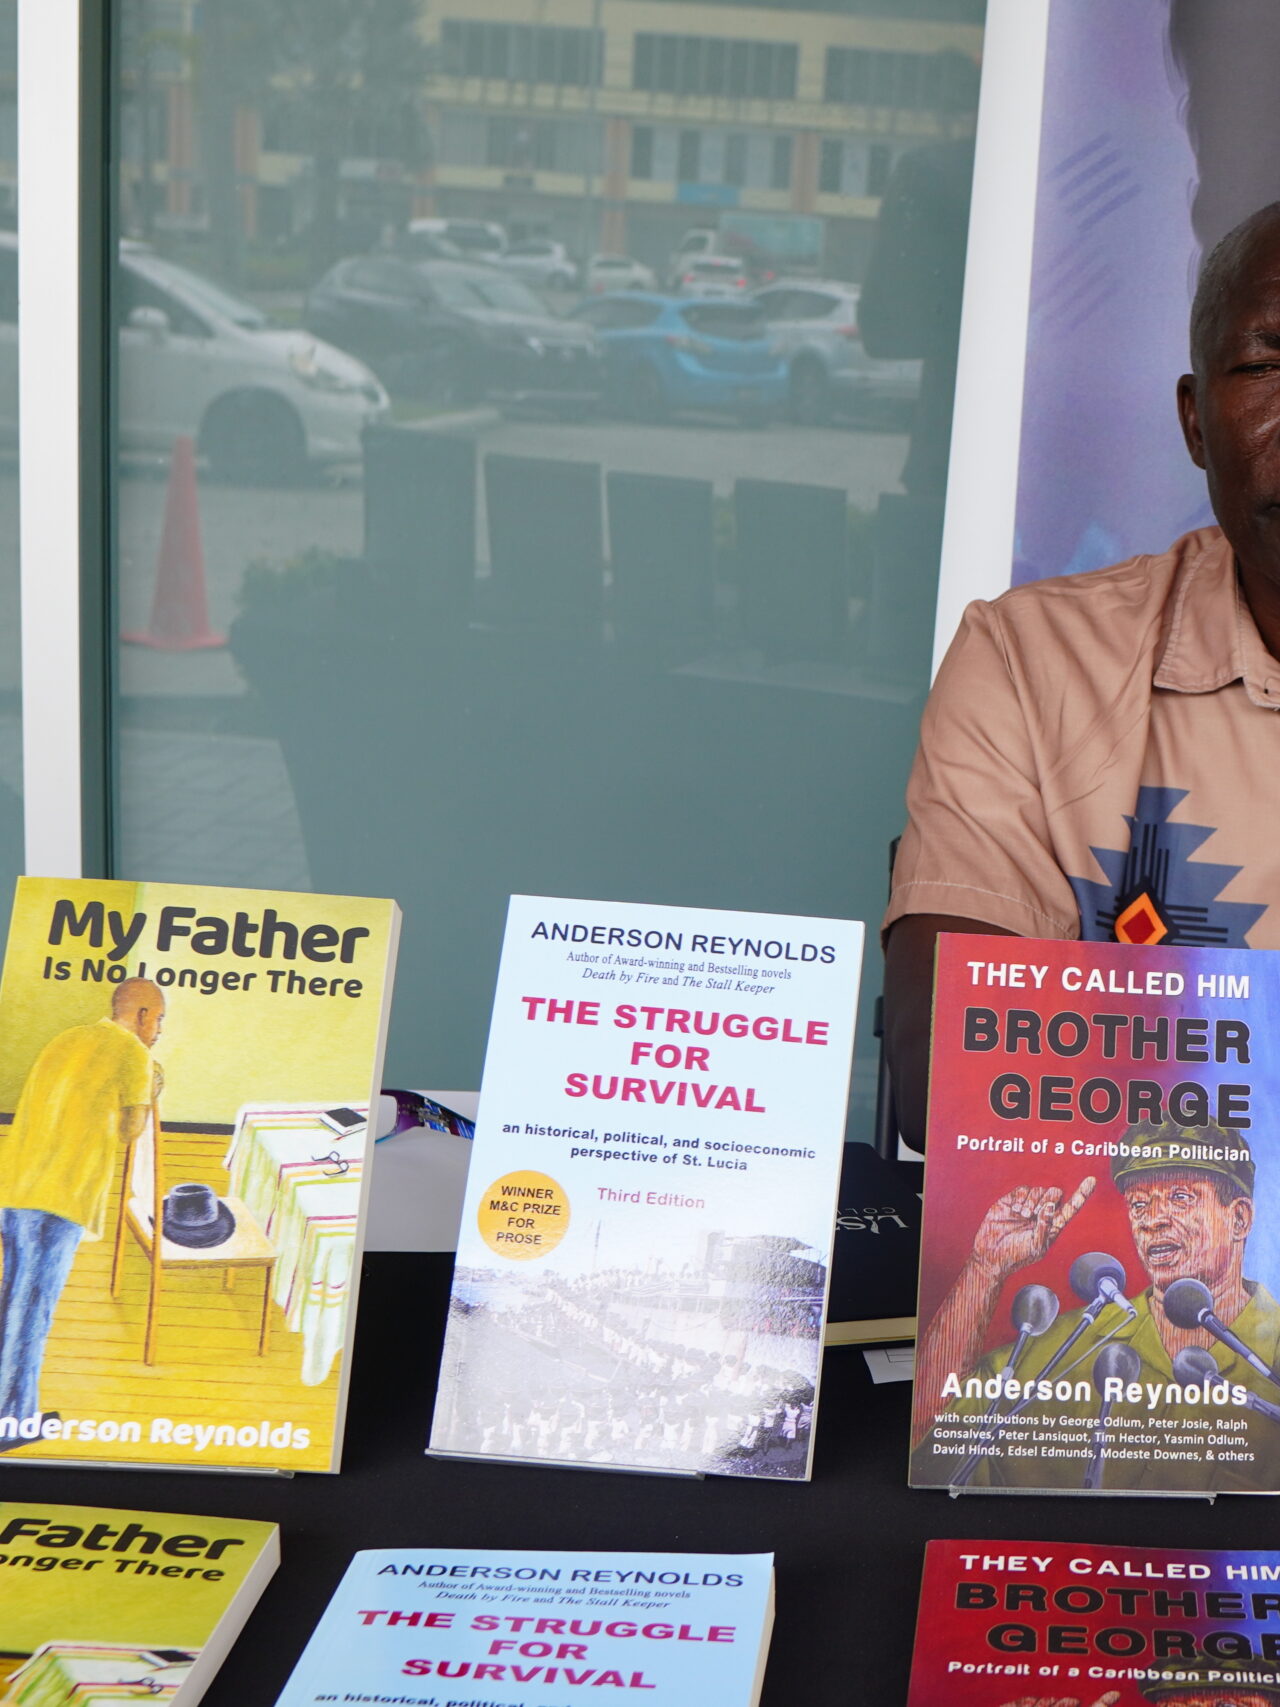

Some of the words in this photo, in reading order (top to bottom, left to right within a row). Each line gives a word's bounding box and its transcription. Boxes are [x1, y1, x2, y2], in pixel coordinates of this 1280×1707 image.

[48, 899, 147, 961] My
[157, 906, 370, 964] Father
[531, 921, 683, 951] ANDERSON
[691, 934, 835, 964] REYNOLDS
[43, 956, 71, 981] Is
[81, 959, 127, 983] No
[266, 969, 363, 999] There
[566, 951, 600, 963] Author
[601, 953, 614, 964] of
[613, 954, 685, 973] Award-winning
[687, 961, 705, 972] and
[707, 962, 759, 980] Bestselling
[761, 968, 792, 980] novels
[967, 961, 1049, 988] THEY
[1062, 967, 1184, 996] CALLED
[1198, 974, 1249, 998] HIM
[582, 967, 616, 981] Death
[619, 970, 633, 984] by
[635, 972, 660, 984] Fire
[662, 975, 679, 986] and
[682, 976, 703, 988] The
[705, 978, 733, 990] Stall
[734, 980, 775, 996] Keeper
[522, 996, 600, 1025] THE
[613, 1004, 829, 1046] STRUGGLE
[963, 1006, 1251, 1065] BROTHER
[631, 1042, 710, 1071] FOR
[565, 1073, 765, 1113] SURVIVAL
[988, 1072, 1251, 1130] GEORGE
[502, 1124, 520, 1134] an
[525, 1123, 598, 1143] historical,
[603, 1131, 667, 1148] political,
[672, 1138, 700, 1149] and
[704, 1141, 815, 1159] socioeconomic
[957, 1135, 1024, 1152] Portrait
[1031, 1139, 1048, 1153] of
[1055, 1142, 1064, 1154] a
[1071, 1140, 1162, 1158] Caribbean
[1169, 1144, 1249, 1161] Politician
[571, 1147, 658, 1164] perspective
[662, 1153, 678, 1164] of
[682, 1154, 702, 1166] St.
[707, 1156, 747, 1170] Lucia
[501, 1185, 553, 1200] WINNER
[597, 1187, 640, 1203] Third
[646, 1191, 704, 1208] Edition
[489, 1200, 519, 1213] M&C
[523, 1202, 561, 1216] PRIZE
[507, 1217, 535, 1229] FOR
[496, 1231, 542, 1246] PROSE
[941, 1372, 1091, 1402] Anderson
[1104, 1377, 1248, 1410] Reynolds
[150, 1417, 311, 1452] Reynolds
[934, 1412, 960, 1423] with
[962, 1413, 1039, 1425] contributions
[1042, 1414, 1056, 1428] by
[1059, 1415, 1101, 1429] George
[1103, 1416, 1145, 1429] Odlum,
[1148, 1418, 1179, 1428] Peter
[1181, 1418, 1213, 1431] Josie,
[1216, 1419, 1248, 1432] Ralph
[933, 1428, 995, 1441] Gonsalves,
[998, 1429, 1030, 1440] Peter
[1032, 1430, 1091, 1444] Lansiquot,
[1094, 1431, 1115, 1443] Tim
[1119, 1433, 1160, 1445] Hector,
[1164, 1434, 1204, 1444] Yasmin
[1207, 1434, 1248, 1447] Odlum,
[933, 1444, 965, 1455] David
[968, 1444, 1004, 1457] Hinds,
[1008, 1445, 1038, 1457] Edsel
[1041, 1446, 1096, 1460] Edmunds,
[1100, 1448, 1150, 1459] Modeste
[1154, 1449, 1202, 1462] Downes,
[1205, 1450, 1215, 1461] &
[1218, 1450, 1255, 1461] others
[0, 1518, 244, 1560] Father
[377, 1564, 561, 1581] ANDERSON
[571, 1569, 743, 1587] REYNOLDS
[359, 1611, 455, 1628] THE
[471, 1615, 736, 1642] STRUGGLE
[488, 1640, 588, 1660] FOR
[402, 1659, 656, 1688] SURVIVAL
